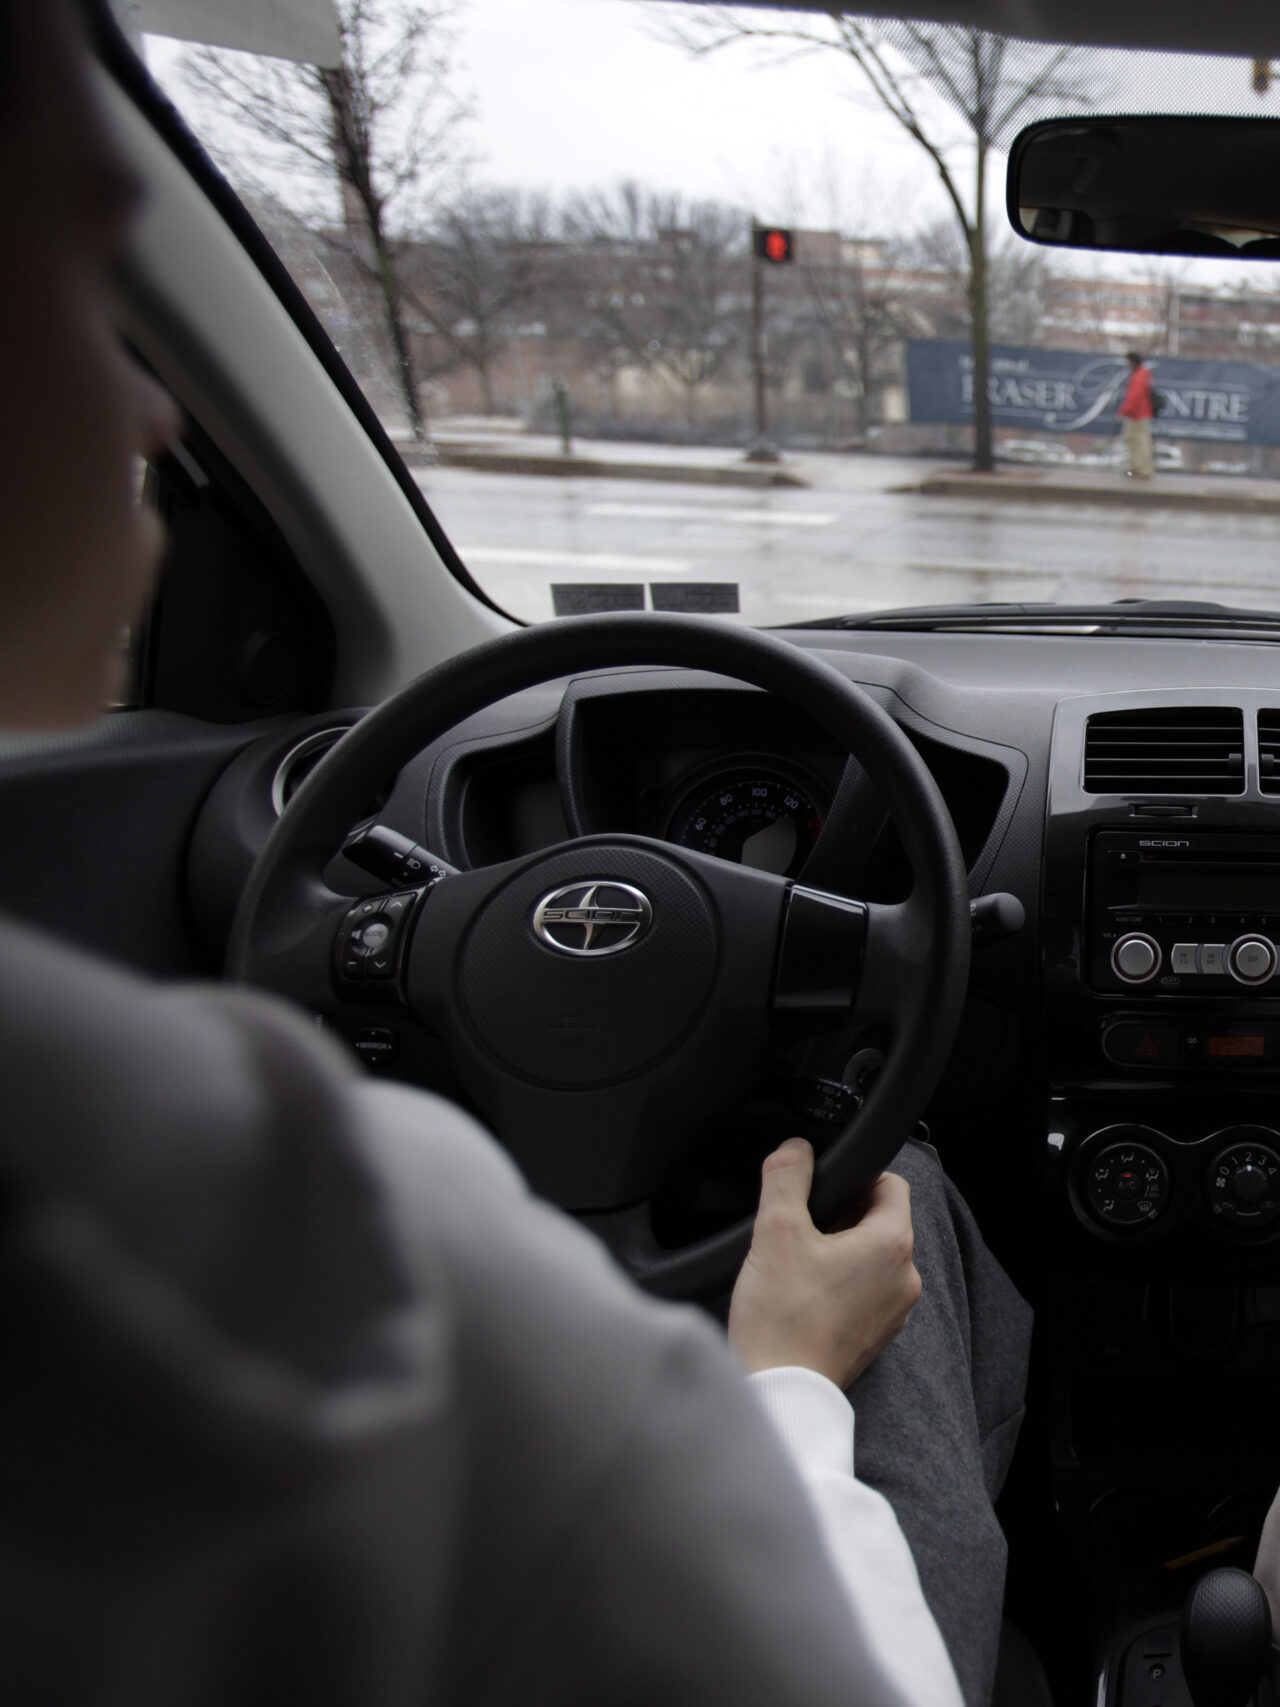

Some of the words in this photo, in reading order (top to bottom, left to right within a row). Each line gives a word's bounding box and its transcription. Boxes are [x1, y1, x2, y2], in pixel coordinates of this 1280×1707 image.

[1159, 389, 1249, 423] NTRE
[751, 787, 768, 797] 100
[719, 794, 733, 806] 80
[783, 795, 800, 809] 120
[694, 817, 707, 831] 60
[543, 909, 638, 922] SCION
[1231, 1156, 1238, 1165] 1
[1245, 1152, 1253, 1162] 2
[1257, 1155, 1266, 1166] 3
[1219, 1166, 1230, 1175] 0
[1268, 1167, 1278, 1175] 4
[1150, 1668, 1161, 1681] P
